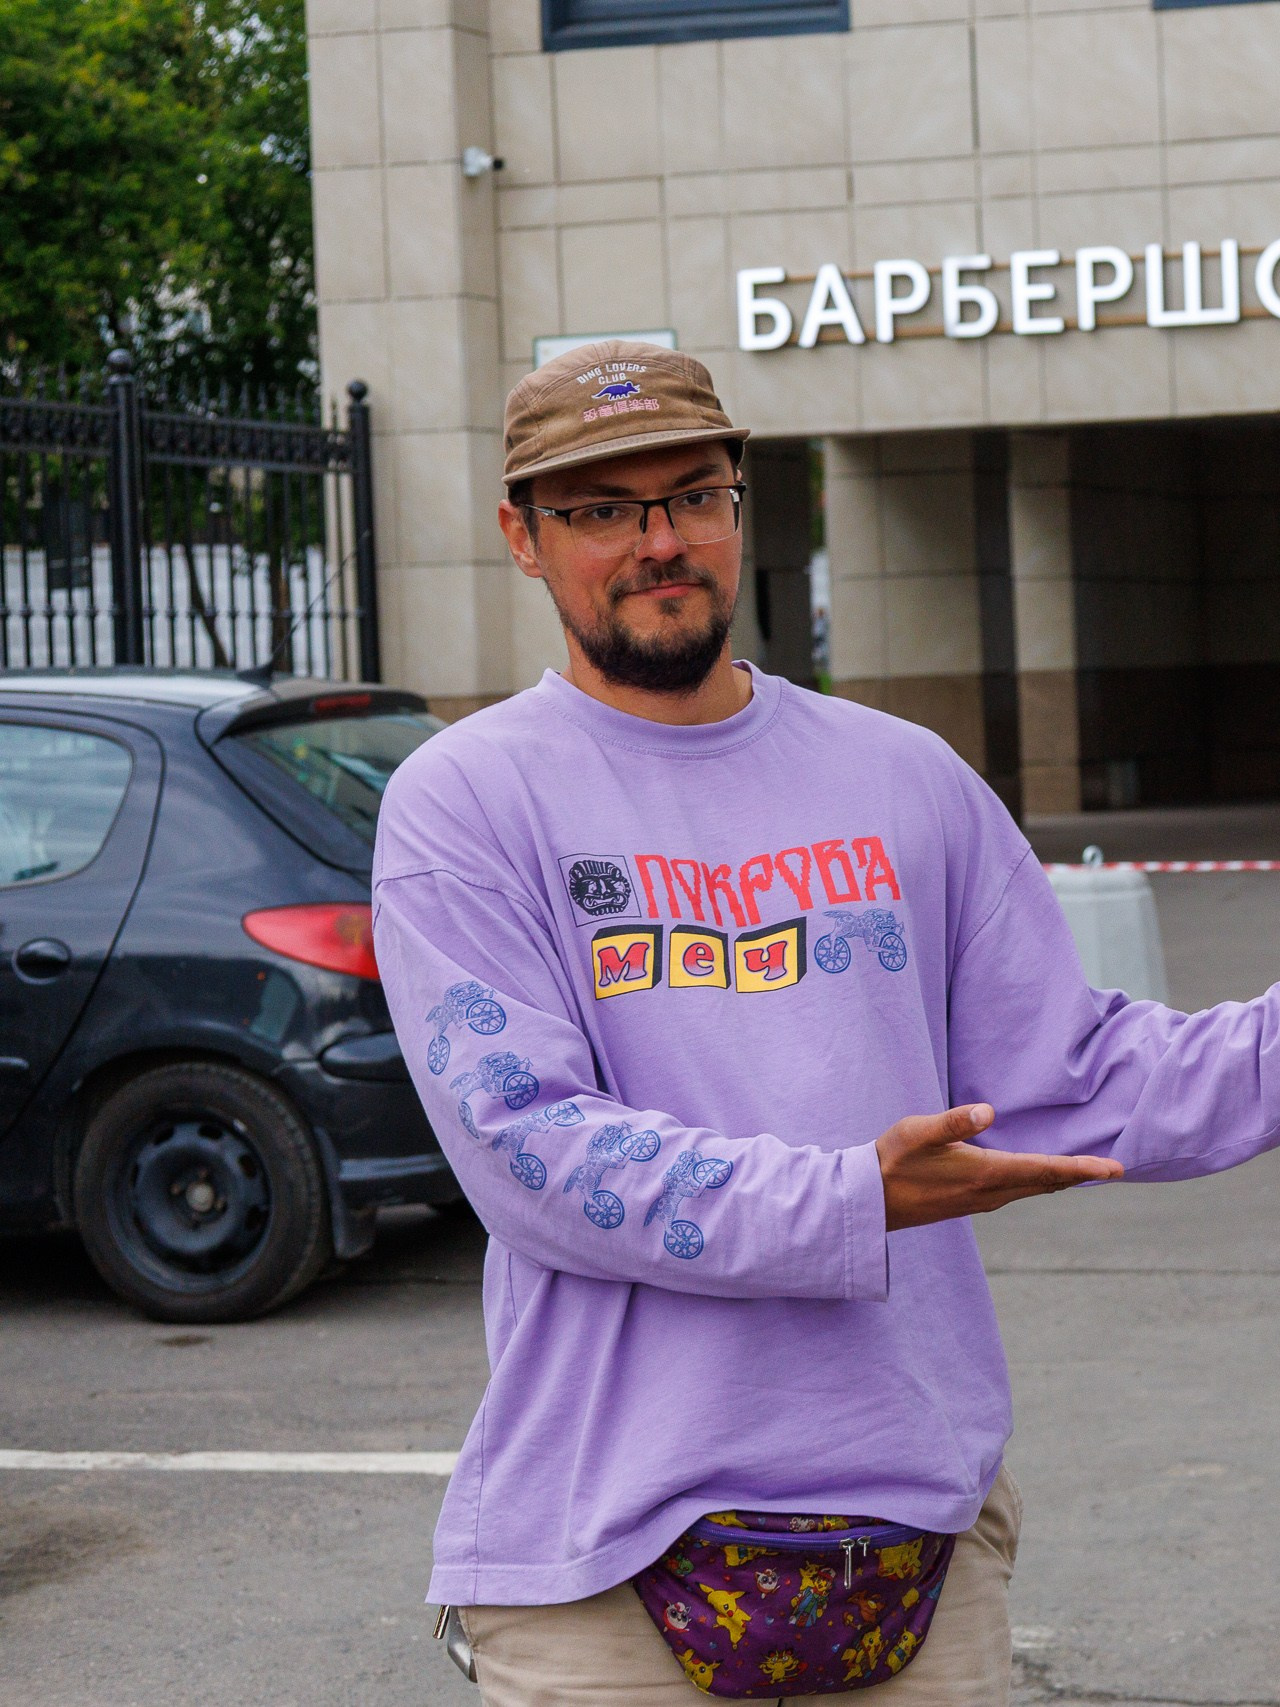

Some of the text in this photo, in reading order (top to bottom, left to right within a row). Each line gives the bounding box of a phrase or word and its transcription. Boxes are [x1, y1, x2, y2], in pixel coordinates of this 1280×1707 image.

[576, 362, 647, 384] DINO LOVERS
[598, 372, 627, 385] CLUB
